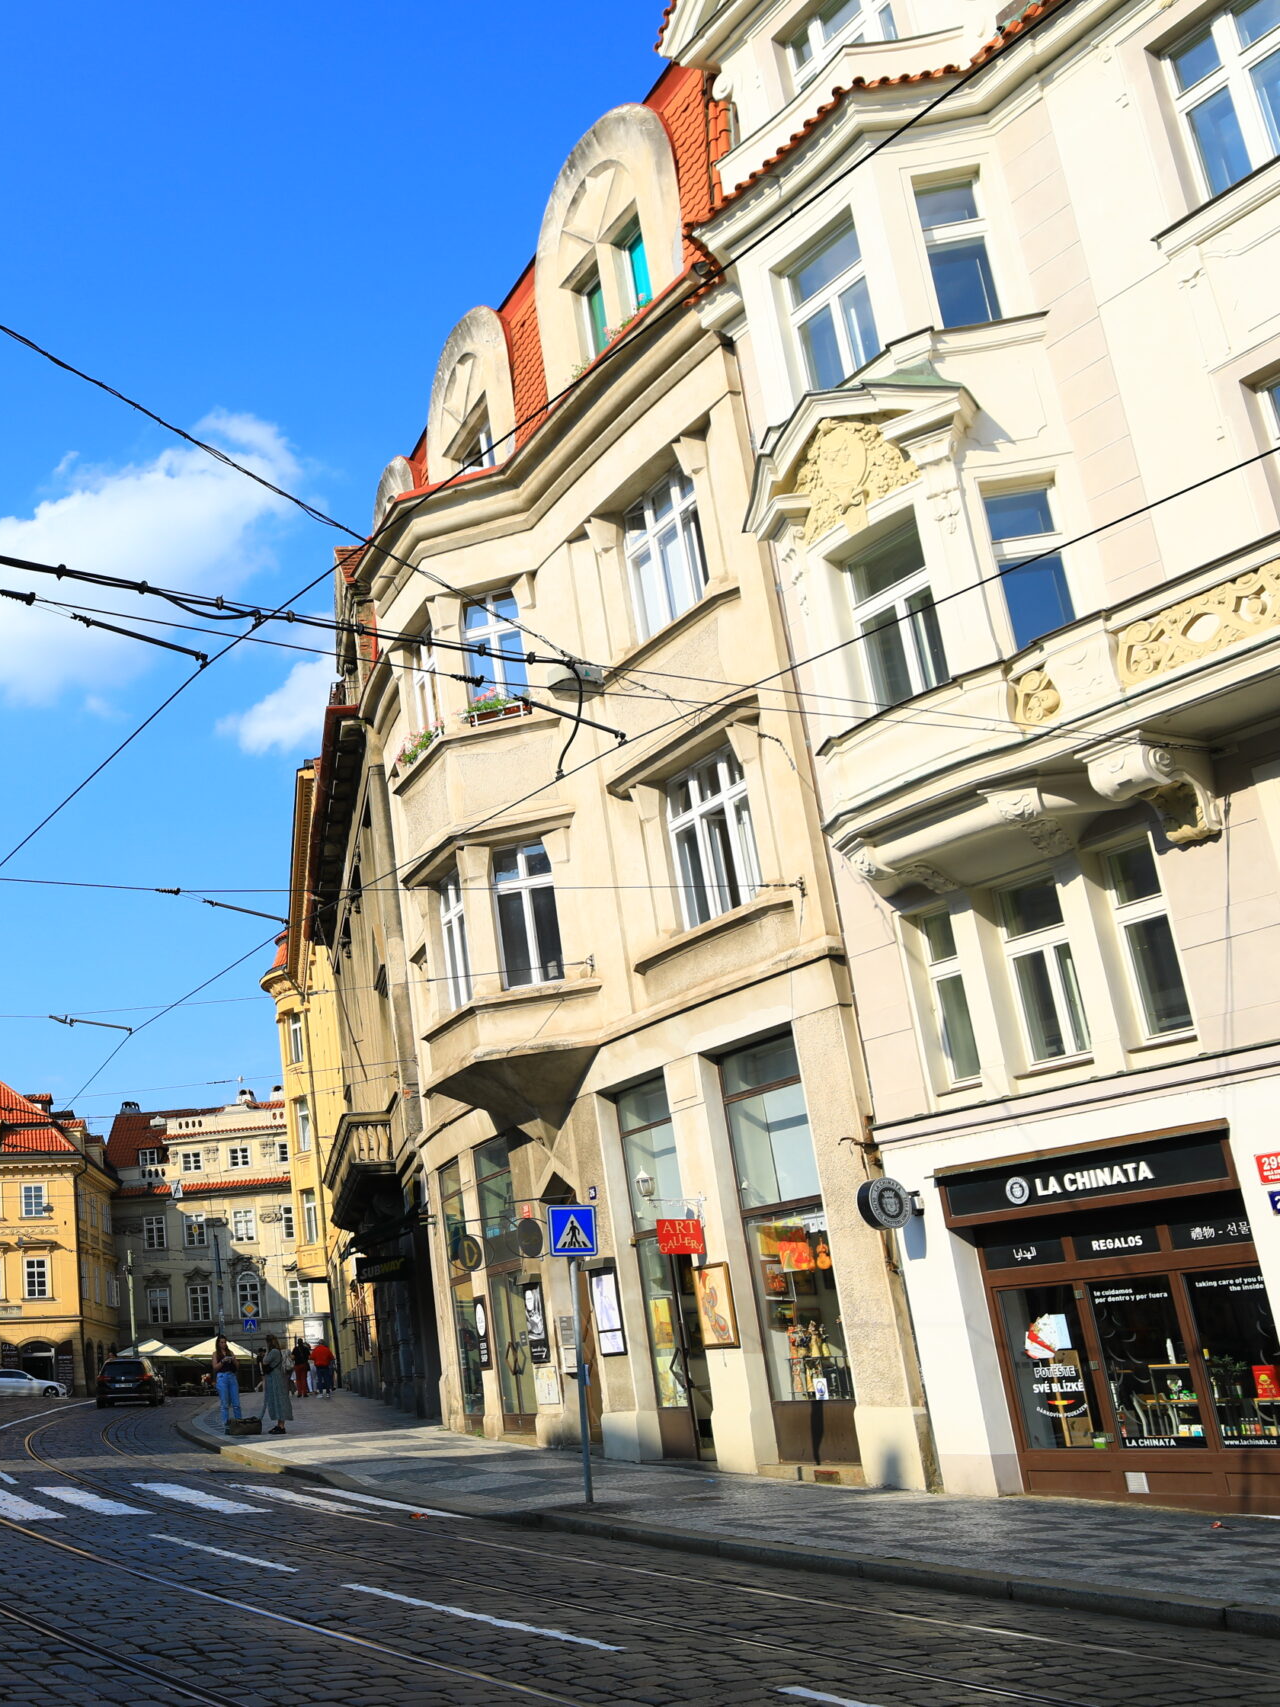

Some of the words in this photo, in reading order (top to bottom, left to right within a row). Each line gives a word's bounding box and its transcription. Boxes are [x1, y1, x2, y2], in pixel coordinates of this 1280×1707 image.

[1035, 1175, 1063, 1197] LA
[1063, 1161, 1155, 1192] CHINATA
[662, 1220, 696, 1234] ART
[659, 1234, 704, 1253] GALLERY
[1091, 1235, 1143, 1252] REGALOS
[360, 1257, 406, 1280] SUBWAY
[1195, 1280, 1218, 1288] taking
[1242, 1283, 1264, 1291] inside
[1101, 1288, 1133, 1296] cuidamos
[1107, 1295, 1130, 1303] dentro
[1033, 1363, 1076, 1379] POTĚŠTE
[1032, 1381, 1051, 1394] SVÉ
[1051, 1379, 1085, 1393] BLÍZKÉ
[1036, 1406, 1064, 1418] DÁRKOVÝM
[1125, 1439, 1138, 1447] LA
[1138, 1438, 1177, 1447] CHINATA
[1224, 1438, 1278, 1446] www.lachinata.cz
